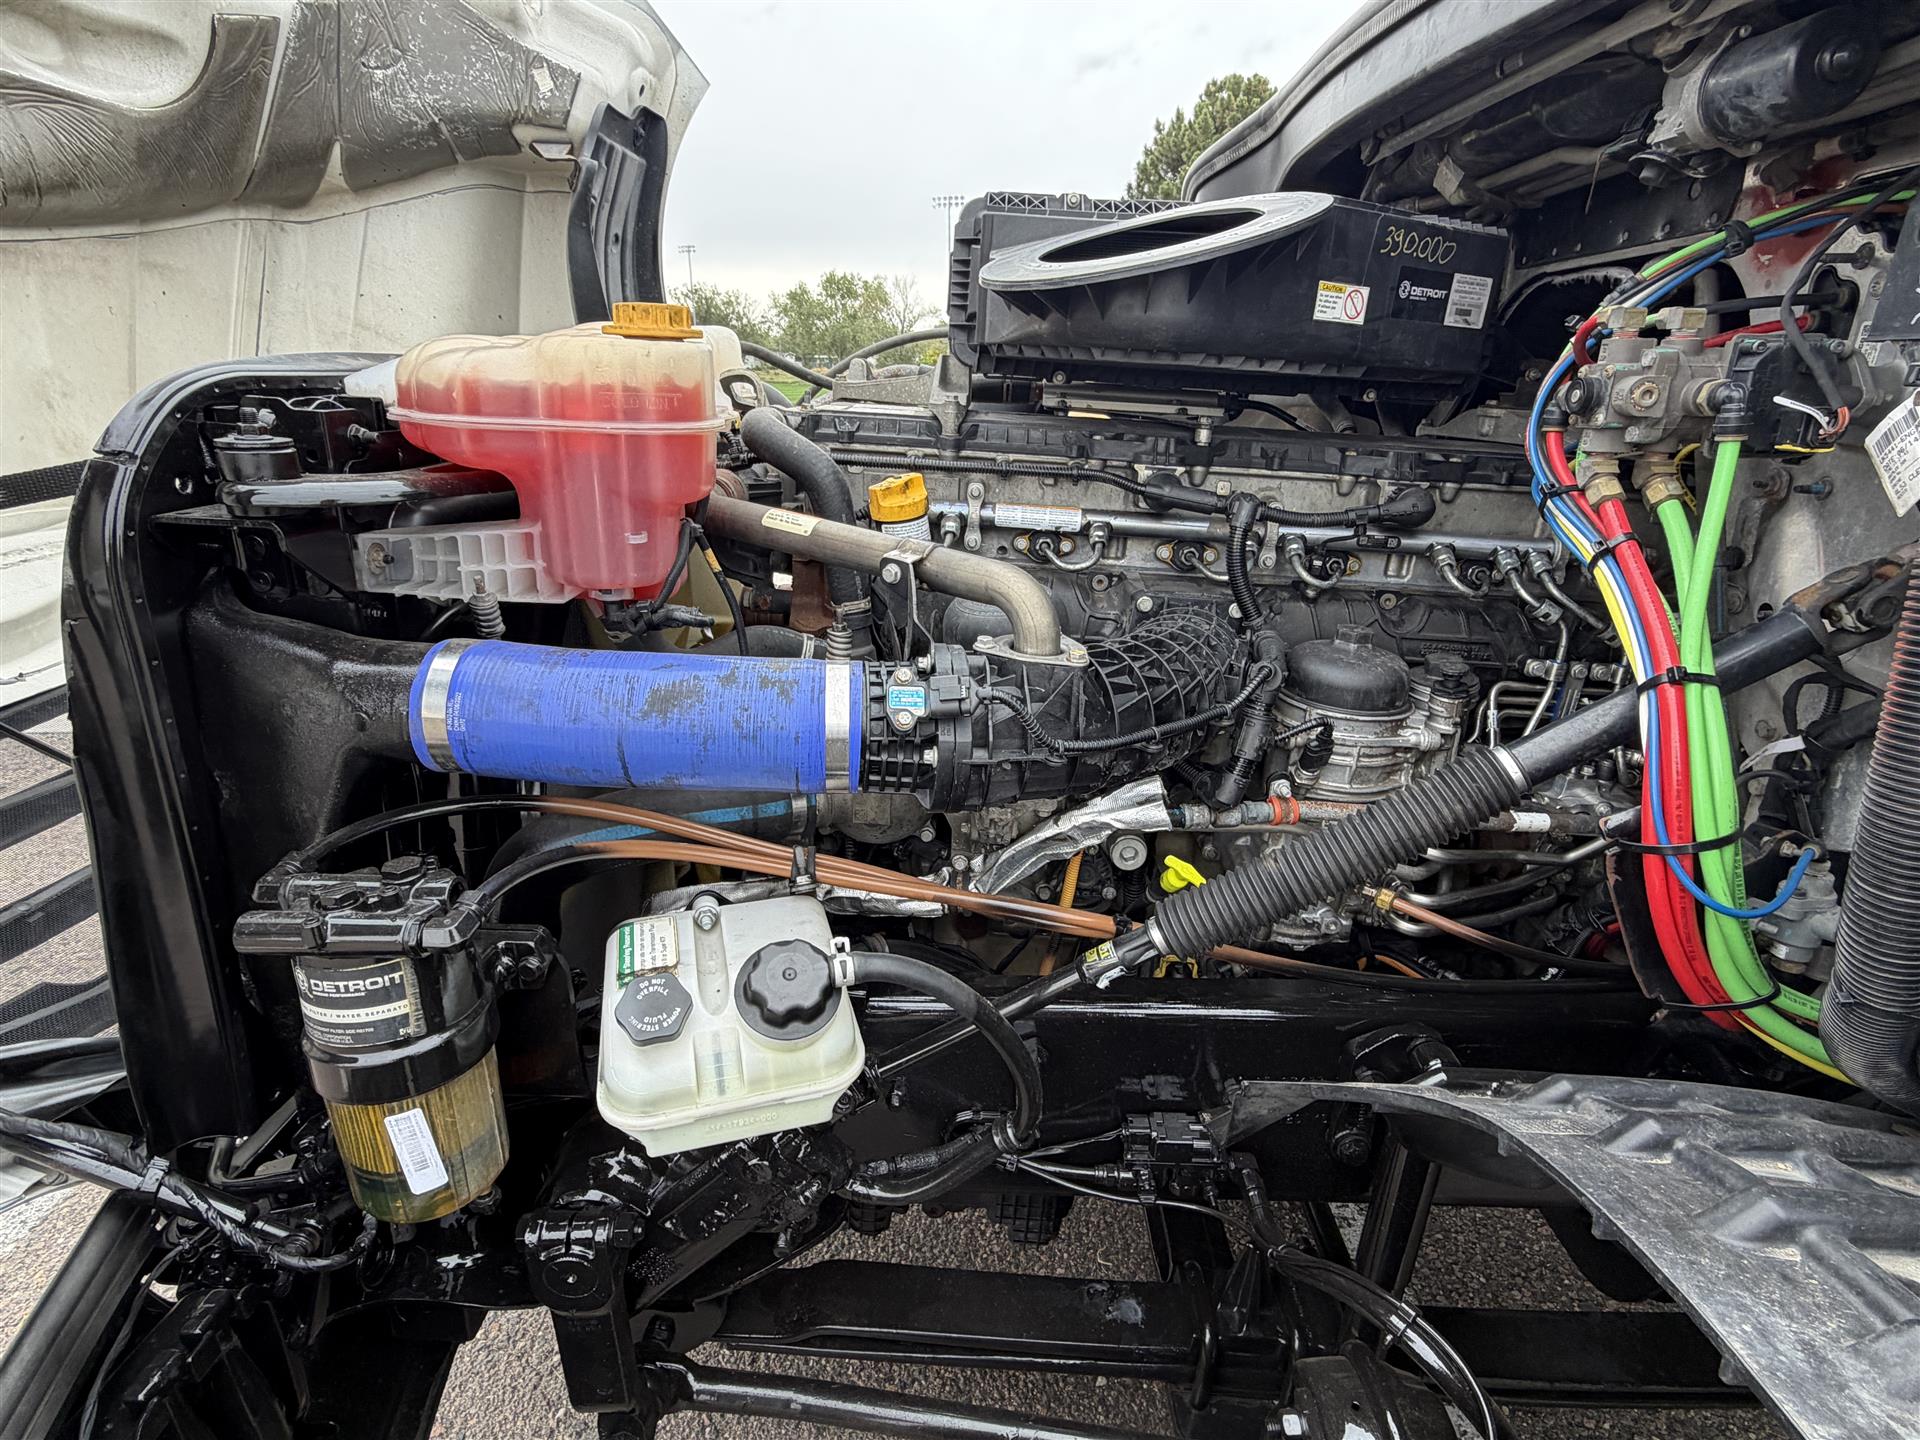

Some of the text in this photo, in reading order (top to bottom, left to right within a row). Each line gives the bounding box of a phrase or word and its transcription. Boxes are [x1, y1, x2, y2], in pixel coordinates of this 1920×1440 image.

[1322, 283, 1344, 292] CAUTION
[1410, 286, 1448, 300] DETROIT
[310, 971, 404, 992] DETROIT
[639, 978, 665, 989] DO NOT
[636, 986, 669, 1000] OVERFILL
[309, 1008, 327, 1017] FILTER
[365, 1003, 412, 1017] SEPARATO
[628, 1007, 681, 1032] POWER STEERING
[643, 1012, 667, 1023] FLUID
